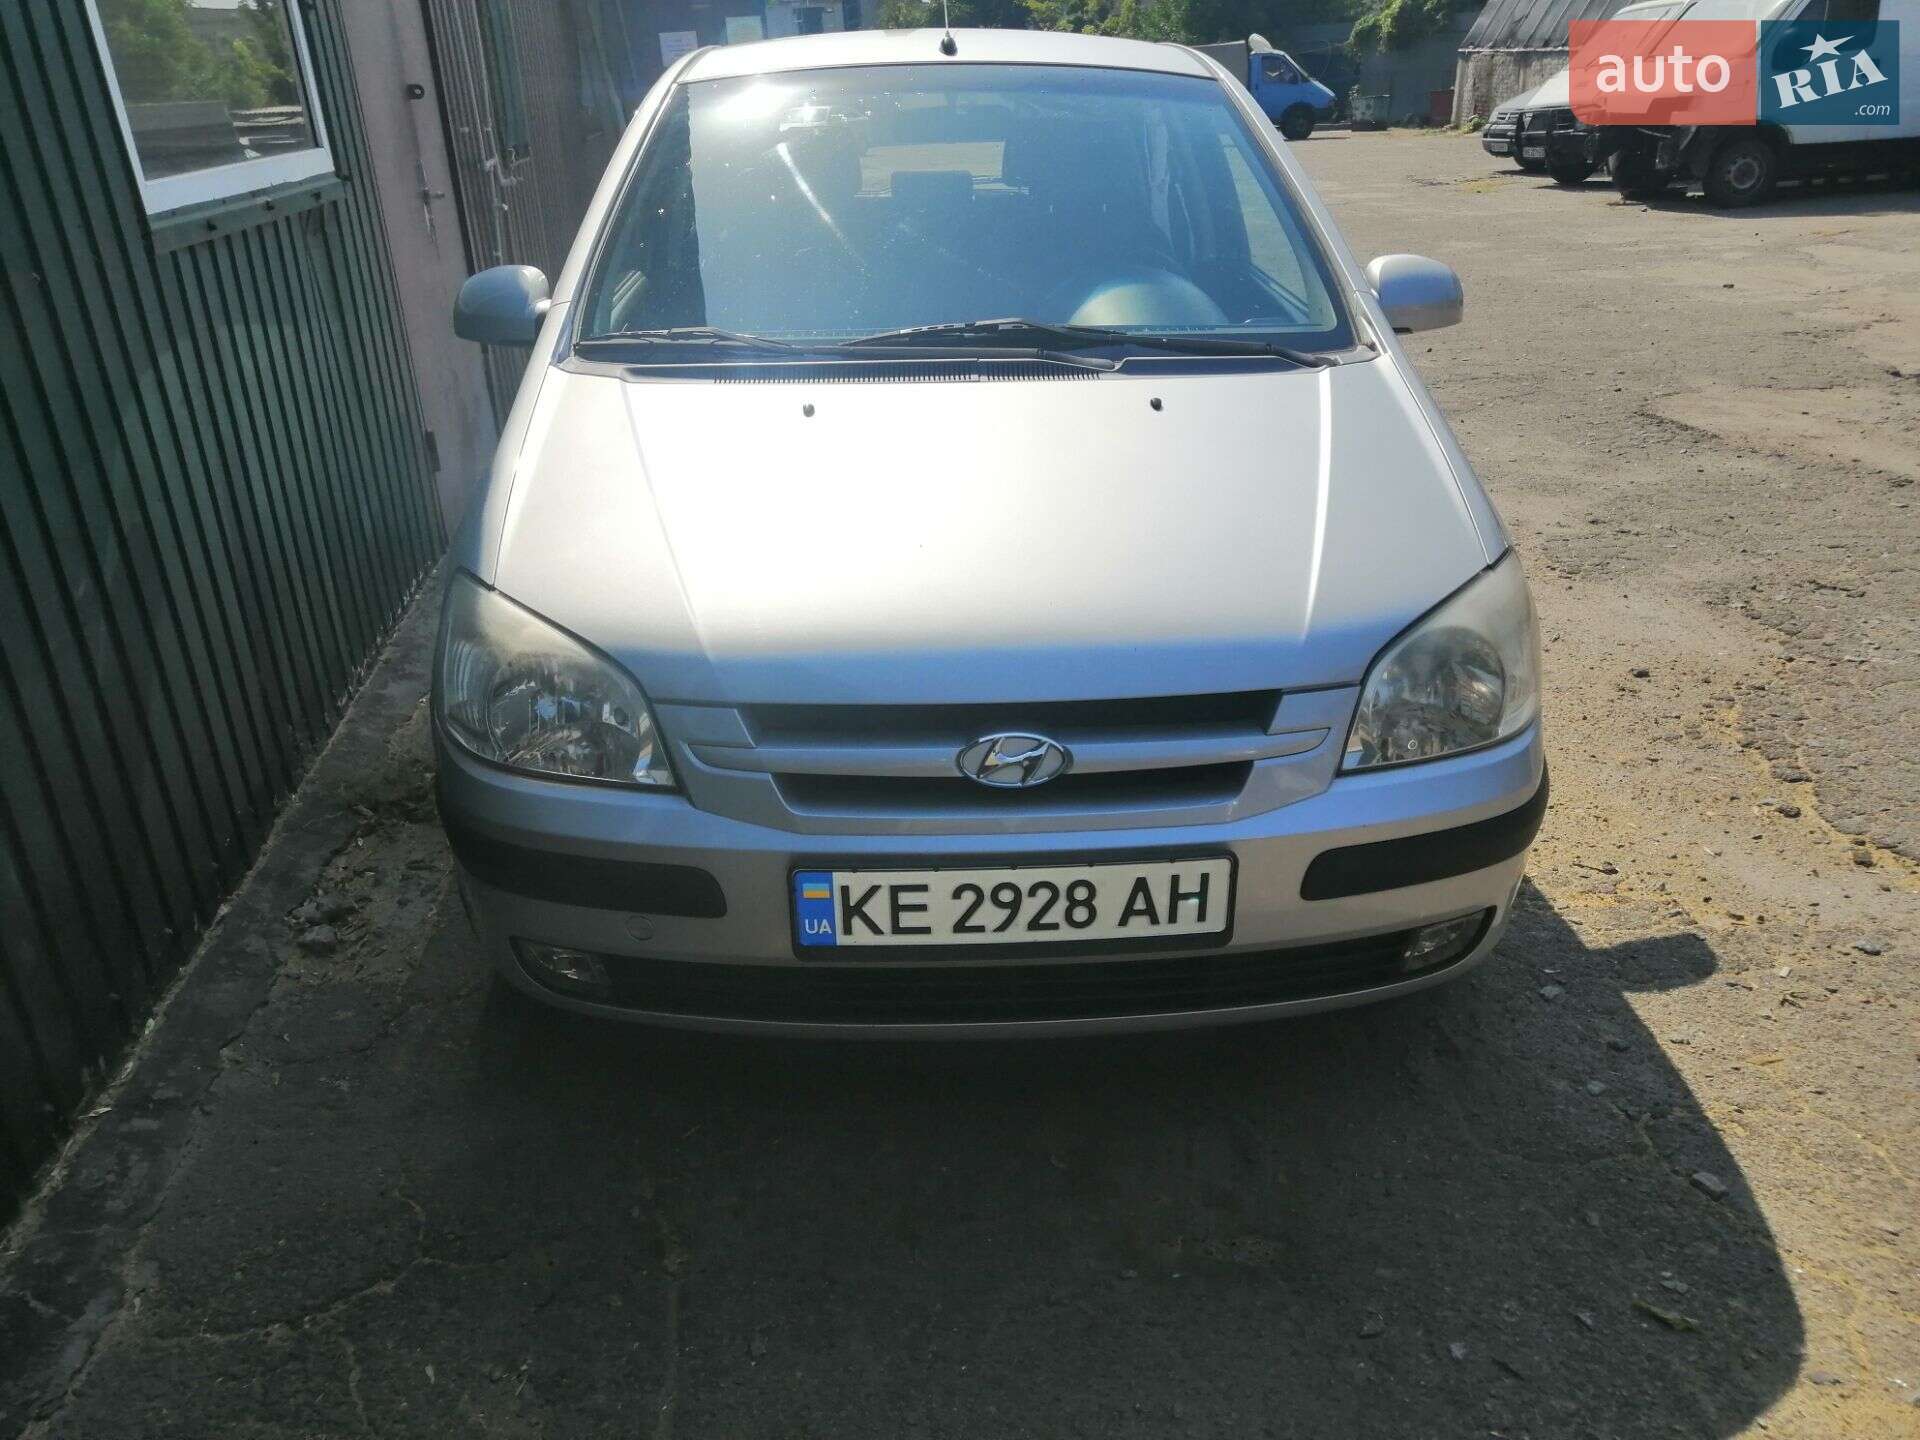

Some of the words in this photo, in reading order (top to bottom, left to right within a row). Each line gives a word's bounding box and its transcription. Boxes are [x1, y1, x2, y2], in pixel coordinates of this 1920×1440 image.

[840, 884, 932, 936] KE
[951, 880, 1098, 934] 2928
[1117, 872, 1210, 927] AH
[804, 918, 833, 935] UA
